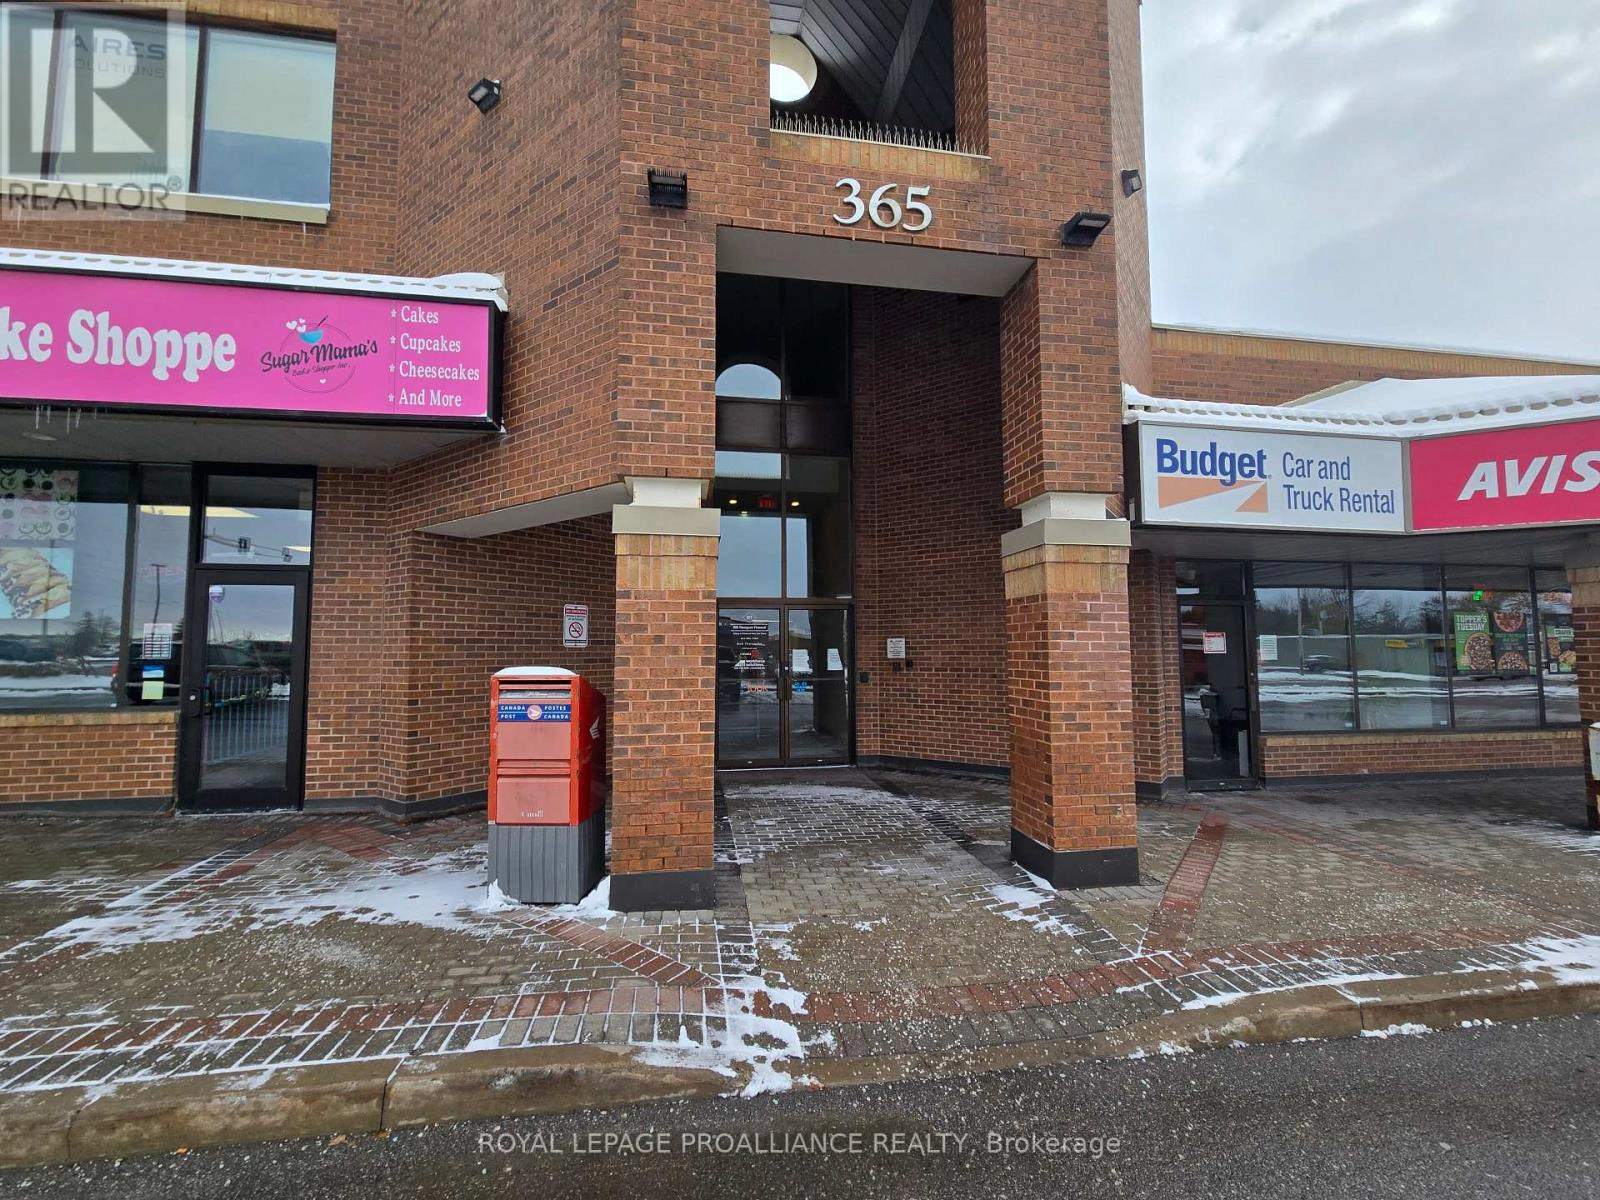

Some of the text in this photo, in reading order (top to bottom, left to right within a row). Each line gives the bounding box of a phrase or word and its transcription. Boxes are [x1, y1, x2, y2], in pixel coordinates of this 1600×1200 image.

[833, 177, 933, 231] 365
[401, 306, 439, 324] Cakes
[66, 308, 237, 382] Shoppe
[260, 340, 378, 373] Sugar Mama's
[400, 333, 461, 355] Cupcakes
[399, 360, 480, 381] Cheesecakes
[399, 388, 462, 408] And More
[1156, 438, 1268, 487] Budget
[1282, 452, 1351, 481] Car and
[1457, 451, 1600, 501] AVIS
[1282, 484, 1395, 514] Truck Rental
[1456, 622, 1485, 631] TUESDAY
